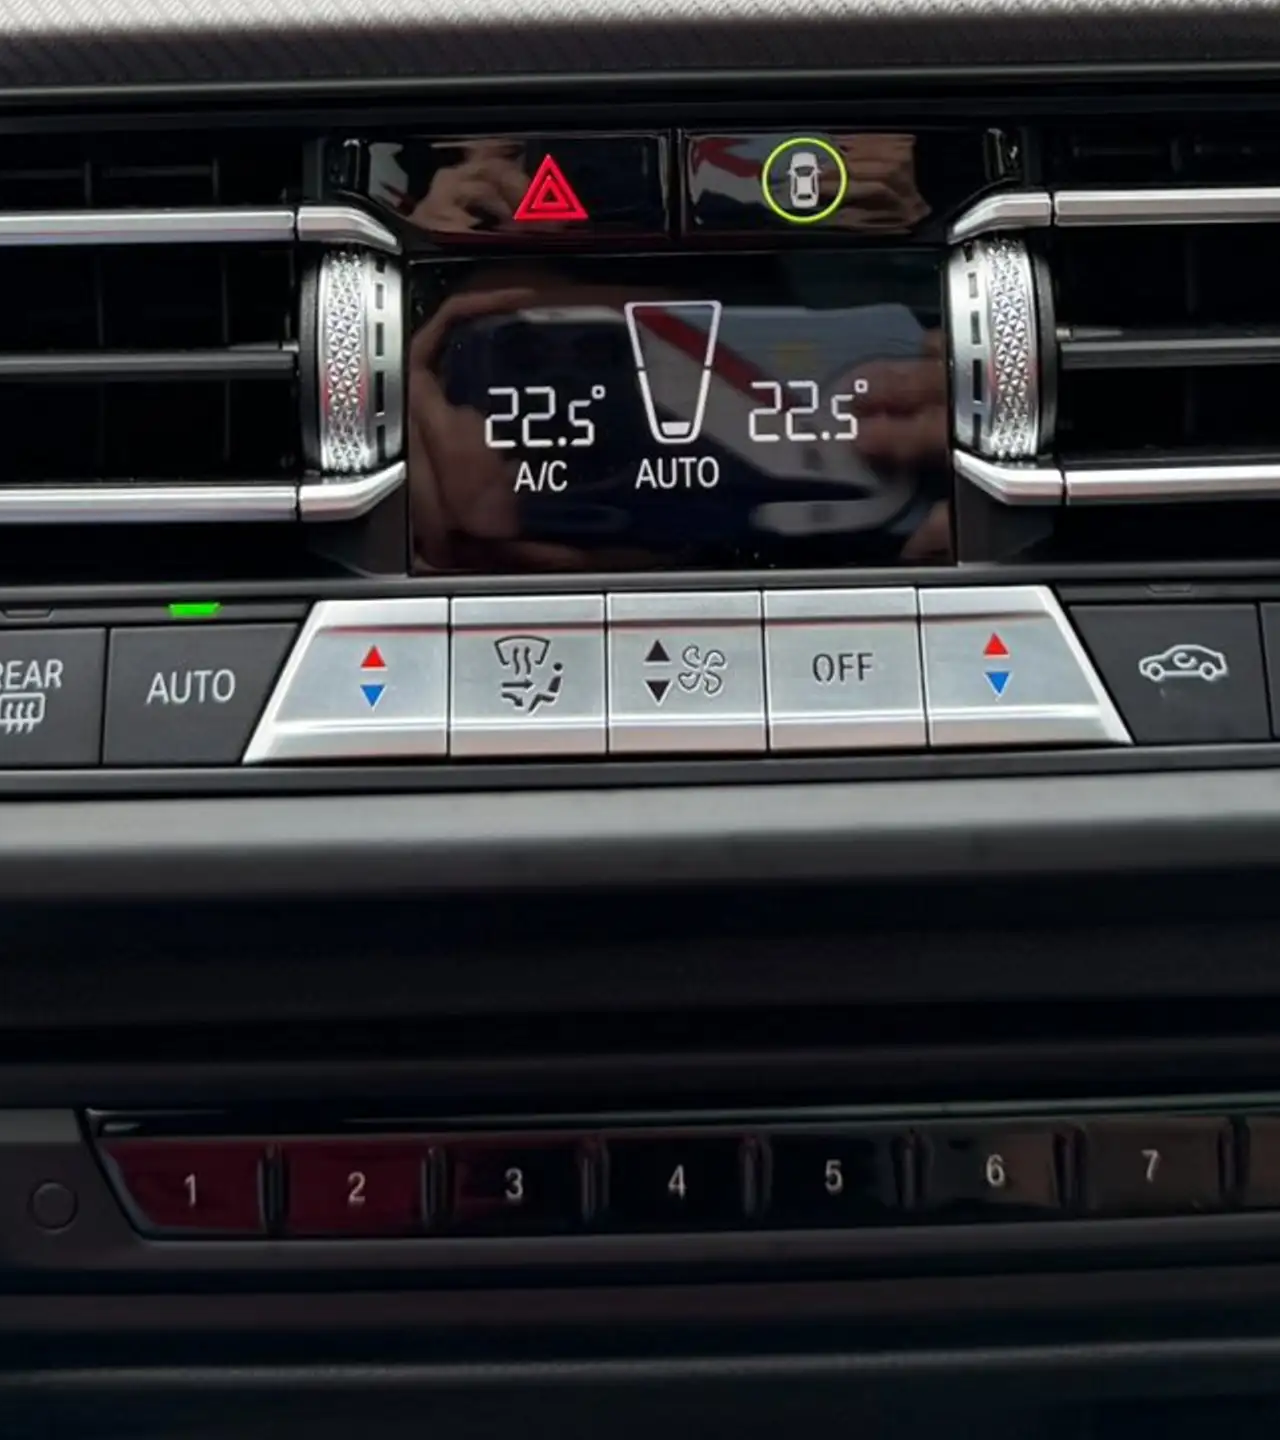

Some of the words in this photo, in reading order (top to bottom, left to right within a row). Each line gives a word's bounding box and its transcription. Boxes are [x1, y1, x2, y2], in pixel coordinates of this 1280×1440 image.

[515, 460, 568, 491] A/C
[635, 456, 720, 489] AUTO
[812, 651, 874, 684] OFF
[146, 669, 236, 704] AUTO
[185, 1175, 197, 1205] 1
[348, 1172, 366, 1203] 2
[505, 1169, 524, 1201] 3
[668, 1165, 686, 1198] 4
[824, 1161, 842, 1192] 5
[986, 1155, 1004, 1187] 6
[1143, 1150, 1159, 1181] 7
